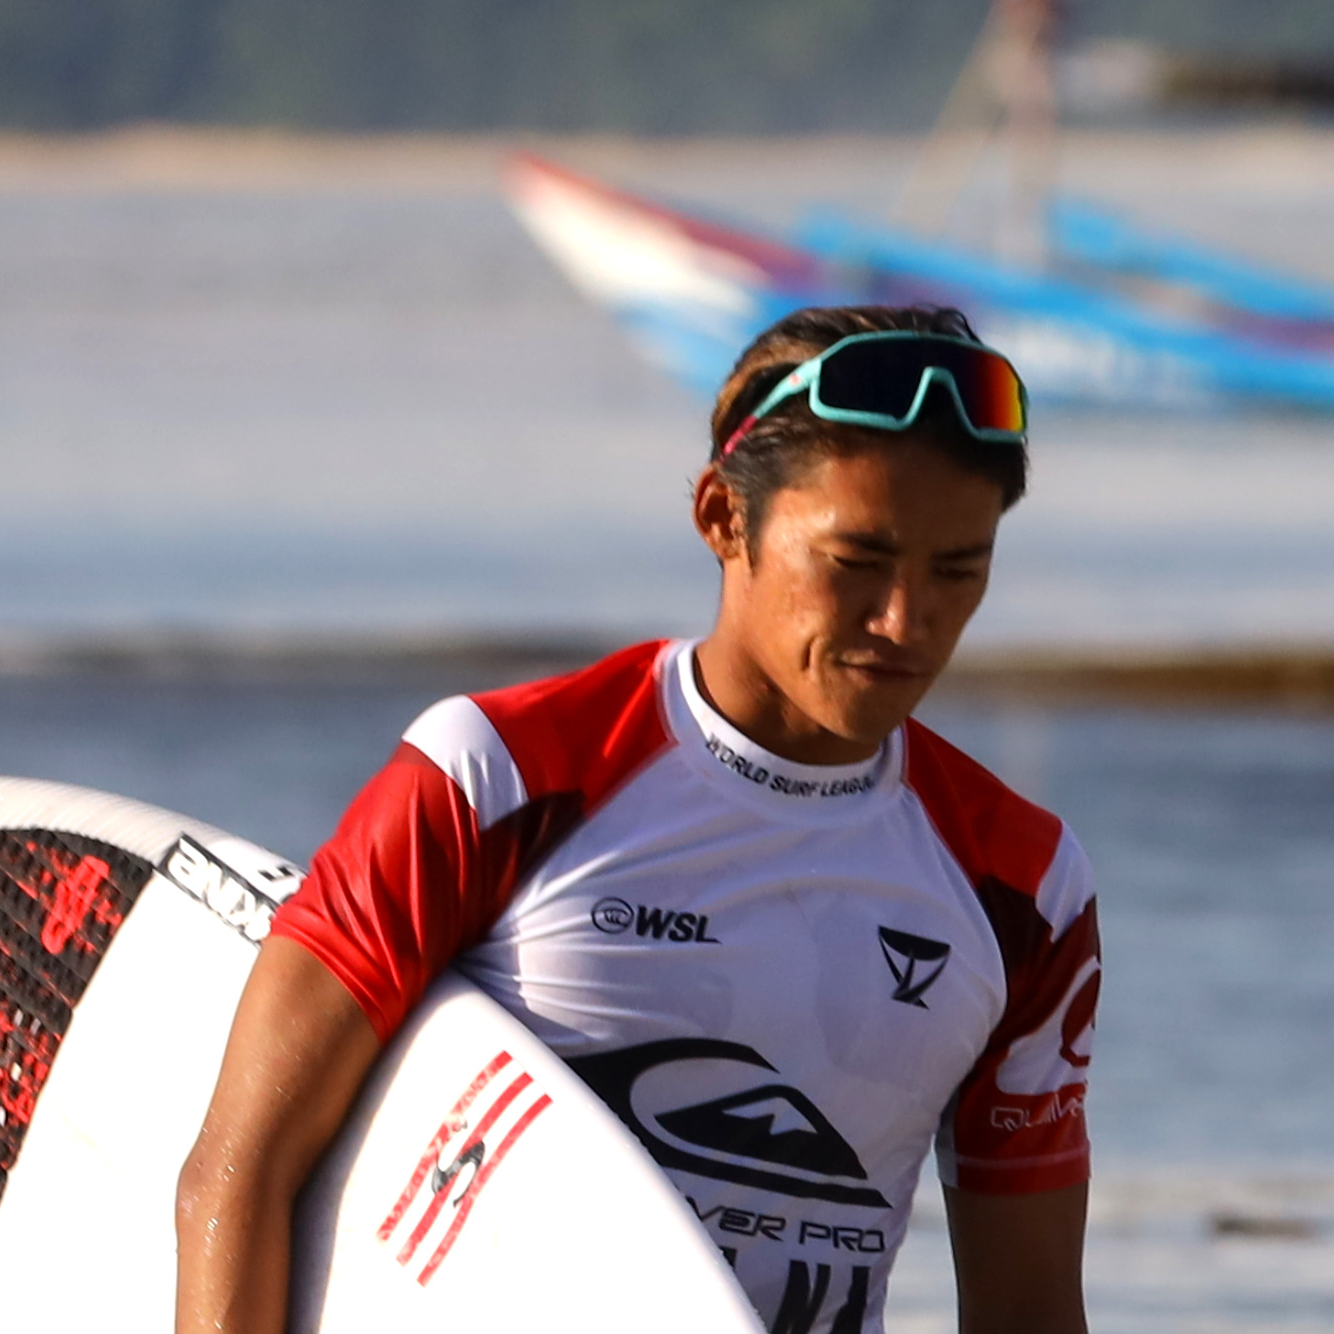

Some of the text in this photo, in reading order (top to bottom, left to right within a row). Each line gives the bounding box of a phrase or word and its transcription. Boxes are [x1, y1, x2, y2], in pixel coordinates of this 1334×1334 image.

[706, 734, 769, 785] WORLD
[769, 774, 819, 798] SURF
[635, 904, 723, 945] WSL
[798, 1220, 886, 1253] PRO
